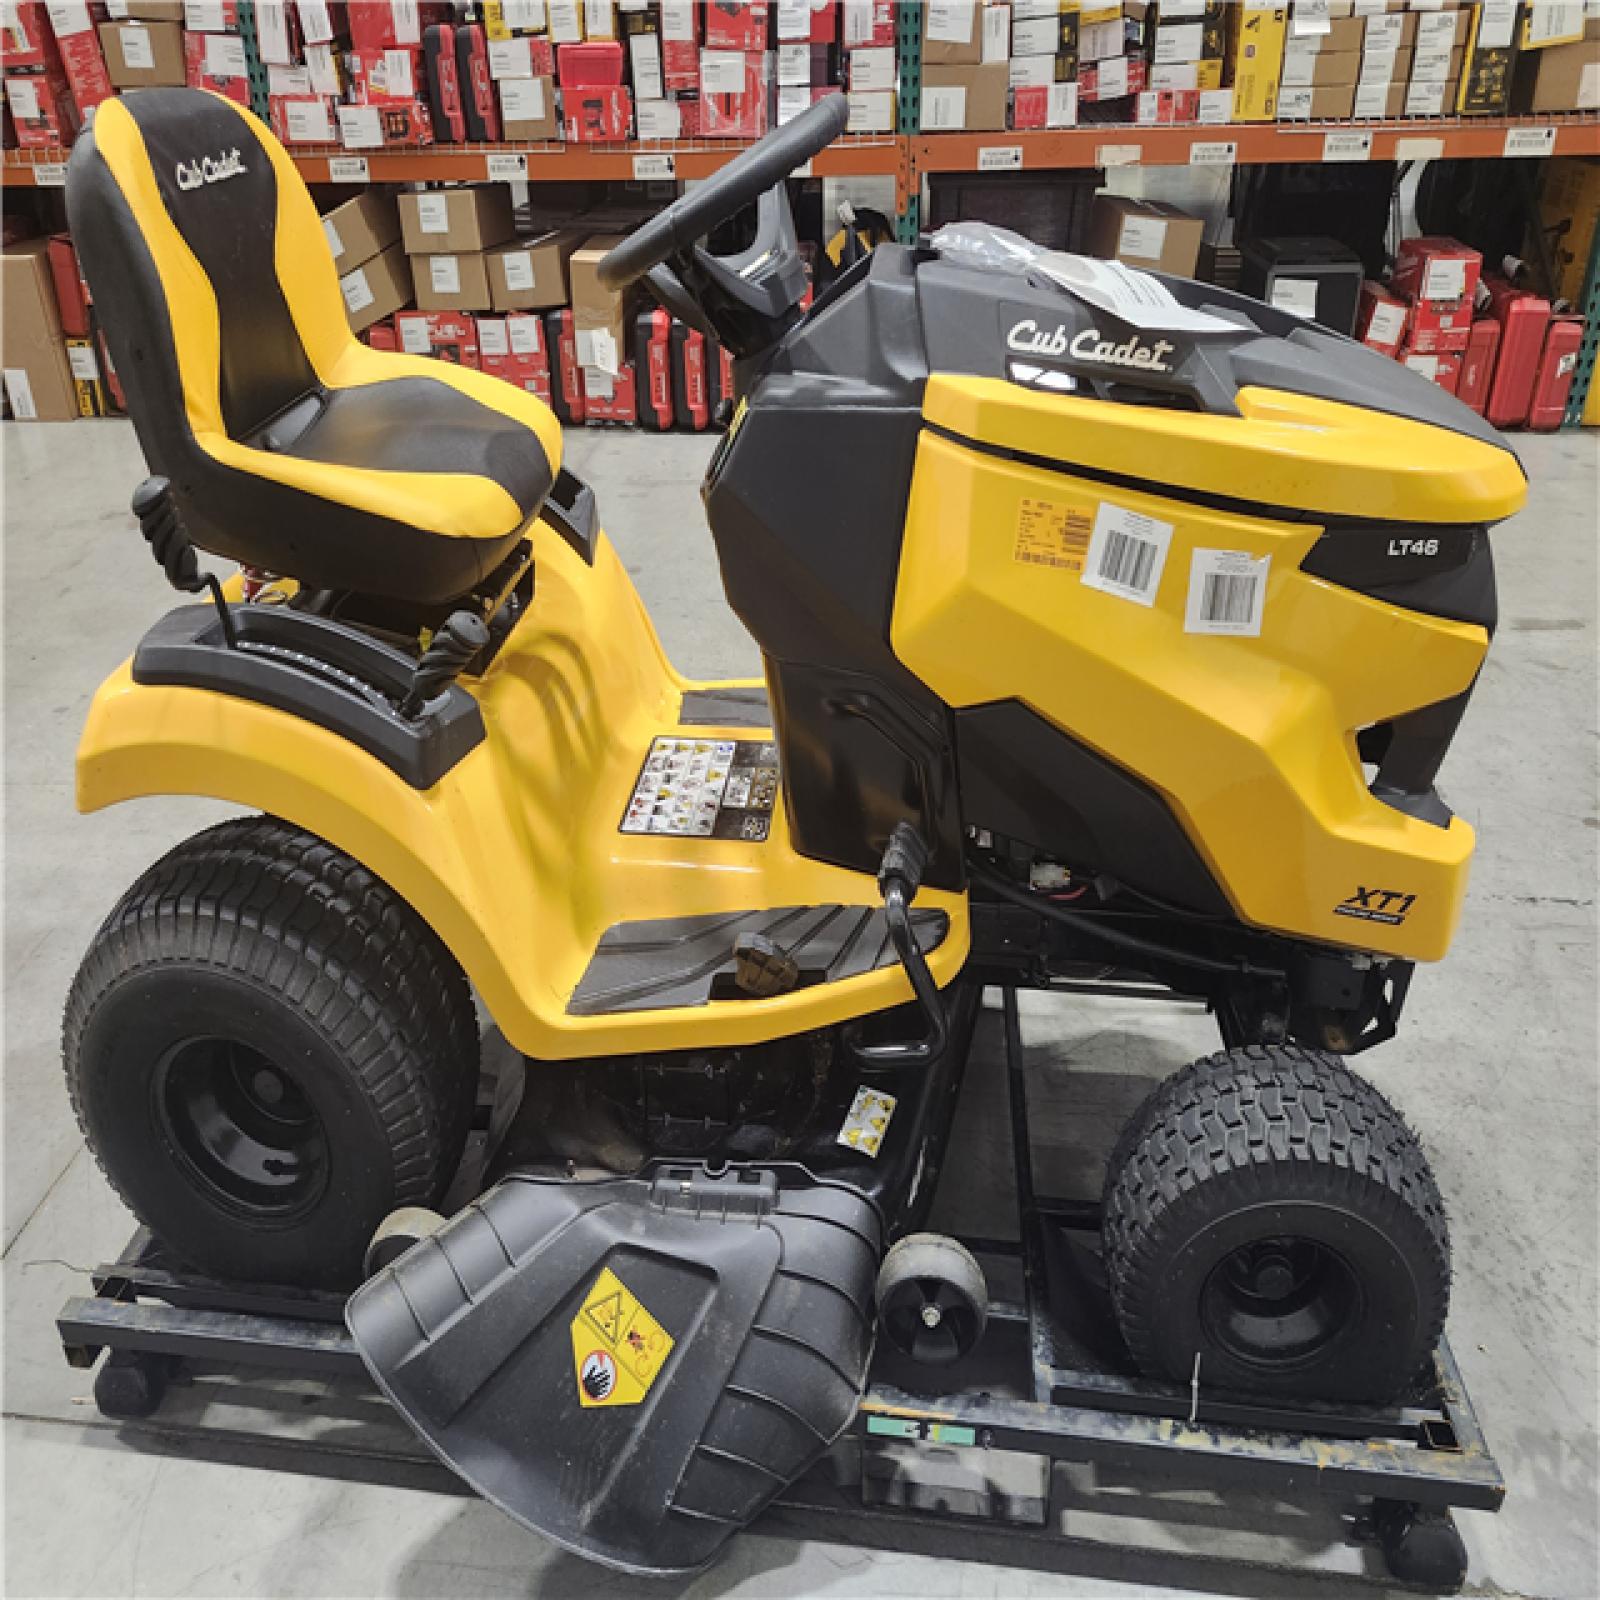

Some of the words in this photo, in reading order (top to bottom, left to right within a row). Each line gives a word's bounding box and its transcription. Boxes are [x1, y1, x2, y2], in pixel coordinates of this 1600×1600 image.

[176, 158, 203, 190] Cub
[202, 147, 248, 183] Cadet
[1007, 319, 1067, 355] Cub
[1069, 329, 1175, 371] Cadet
[1344, 887, 1416, 913] XT1
